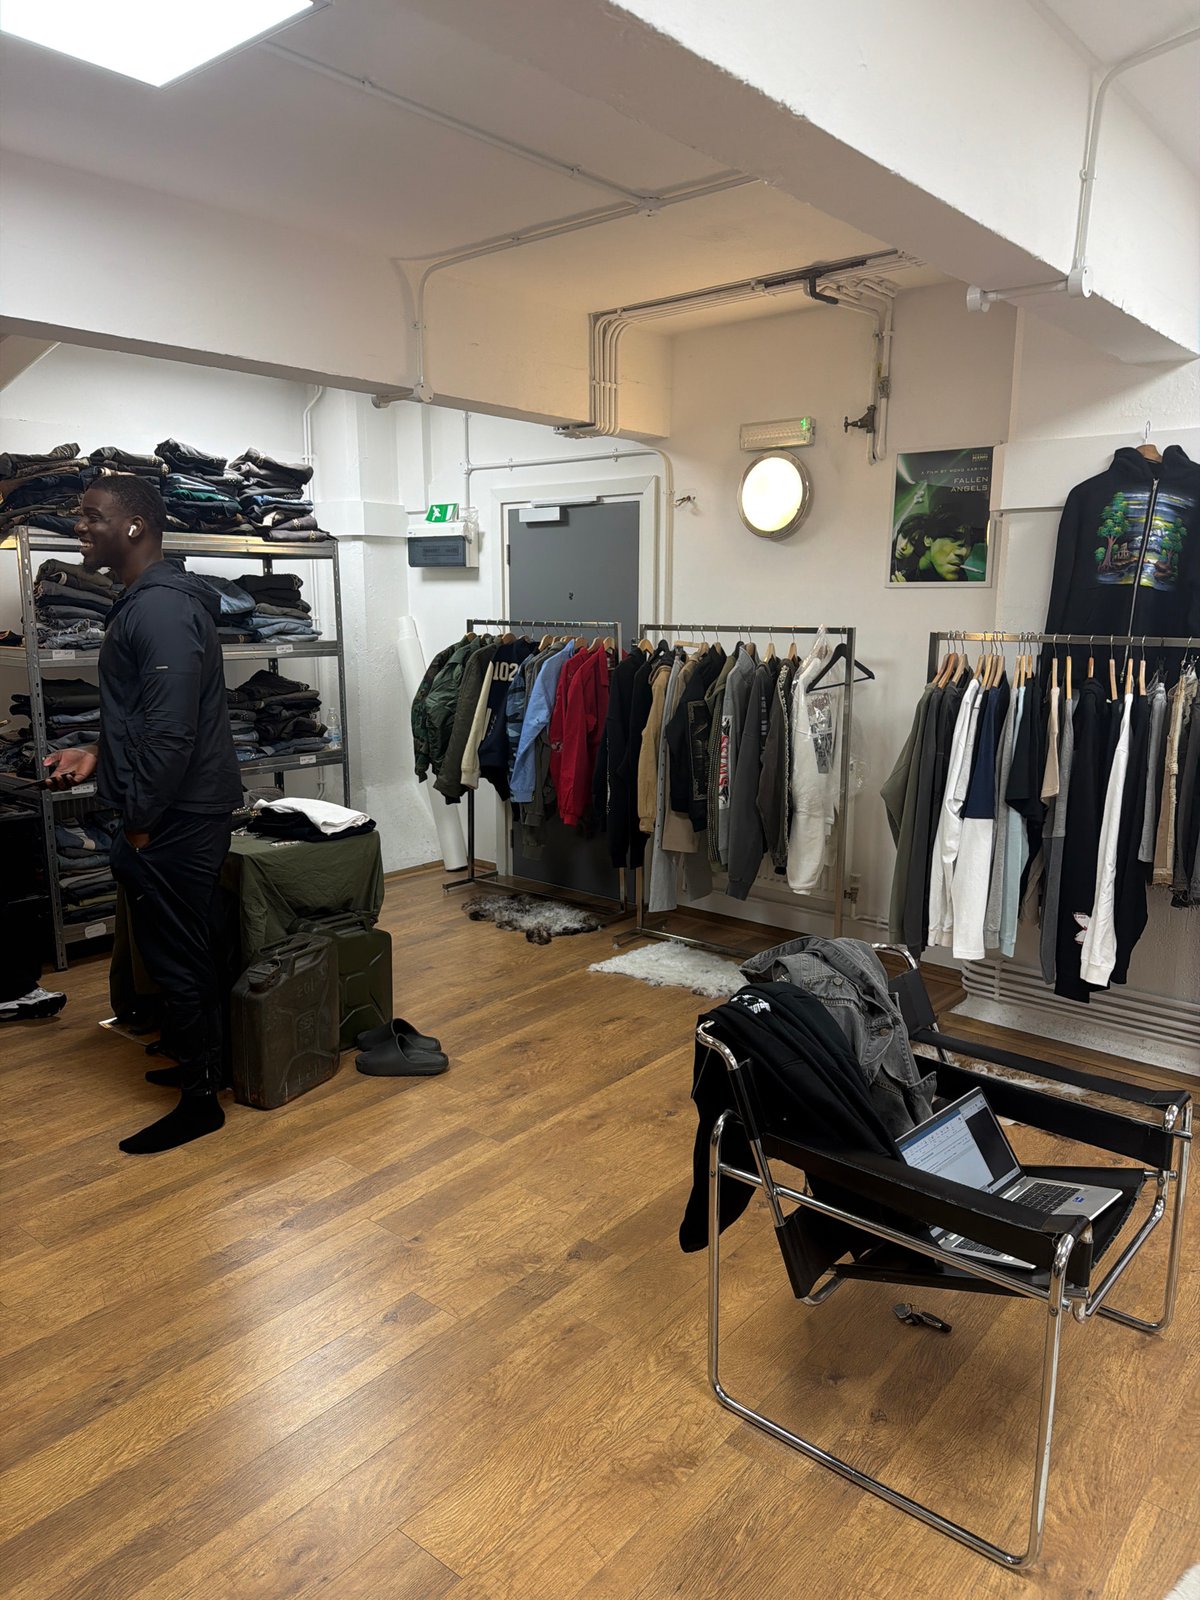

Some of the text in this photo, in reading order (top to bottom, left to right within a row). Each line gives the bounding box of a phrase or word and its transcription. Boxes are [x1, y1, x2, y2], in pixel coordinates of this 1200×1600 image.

[953, 476, 989, 484] FALLEN
[951, 485, 988, 493] ANGELS
[492, 661, 519, 682] 102
